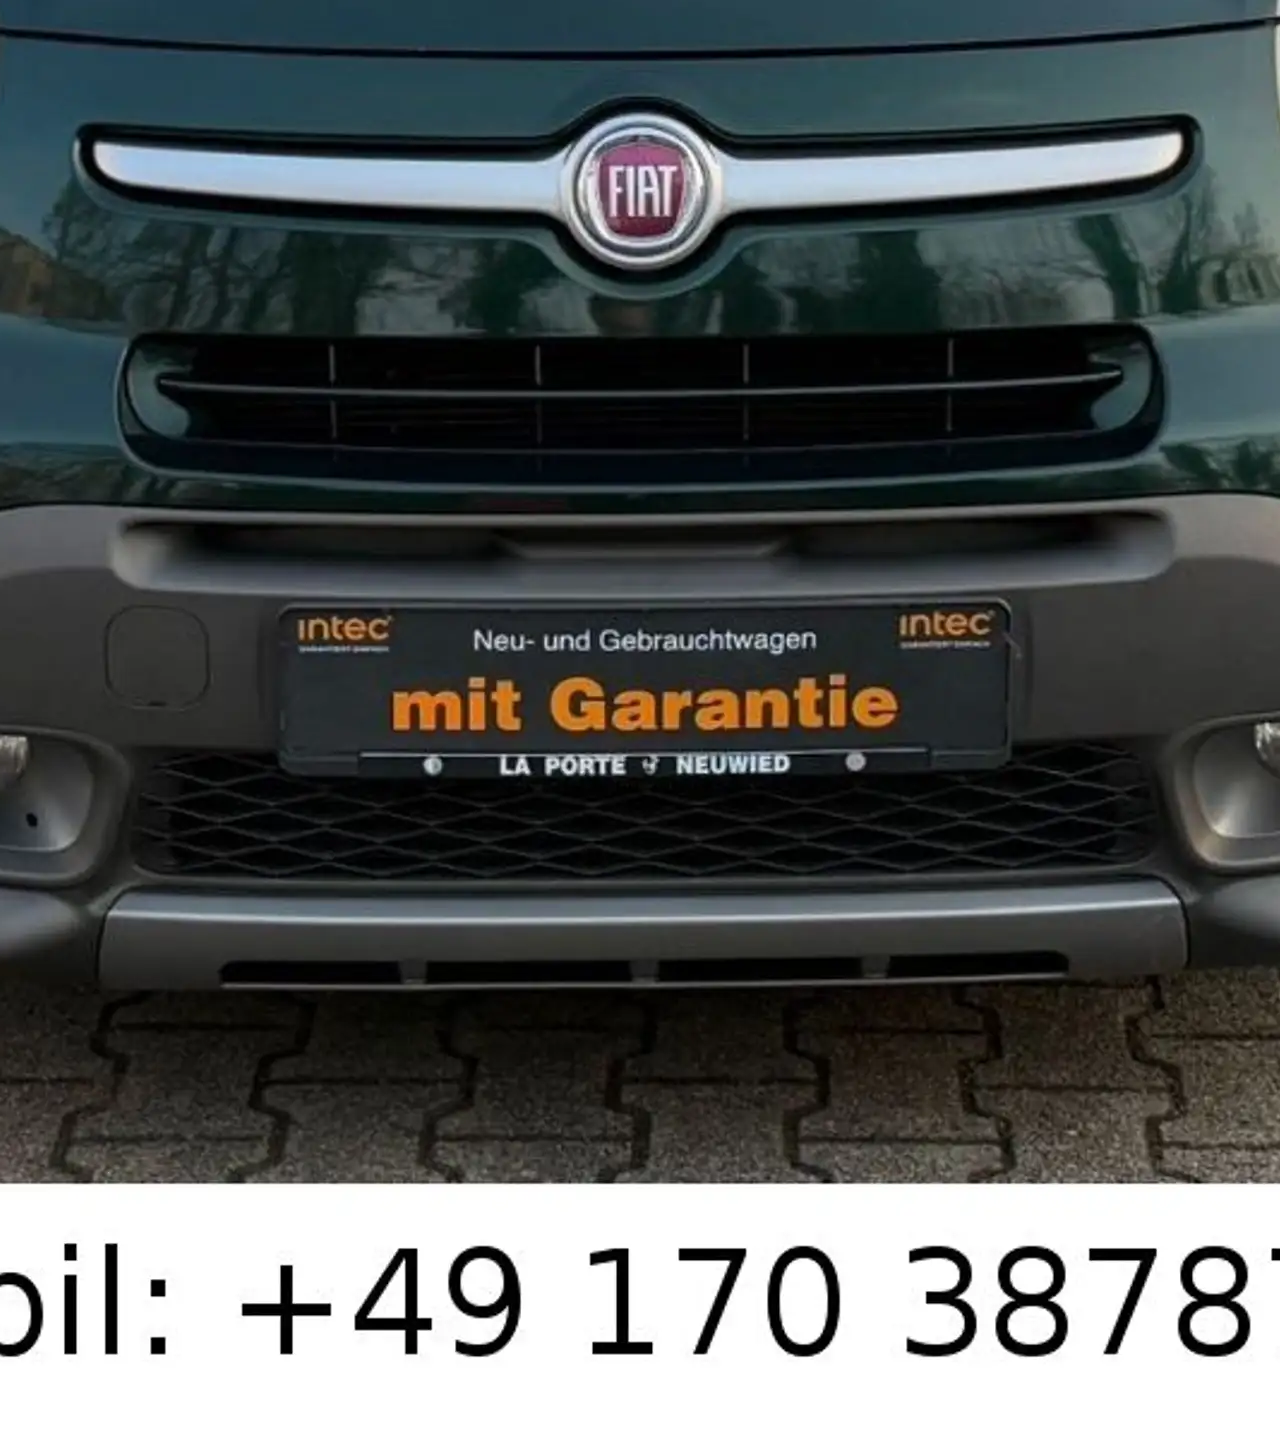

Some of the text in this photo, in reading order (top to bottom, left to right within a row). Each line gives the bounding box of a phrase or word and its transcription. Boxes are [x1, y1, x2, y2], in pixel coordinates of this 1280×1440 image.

[608, 164, 679, 217] FIAT
[297, 615, 390, 641] intec
[900, 611, 992, 637] intec
[473, 628, 818, 655] Neu- und Gebrauchtwagen
[392, 674, 899, 732] mit Garantie
[499, 753, 791, 777] LA PORTE NEUWIED
